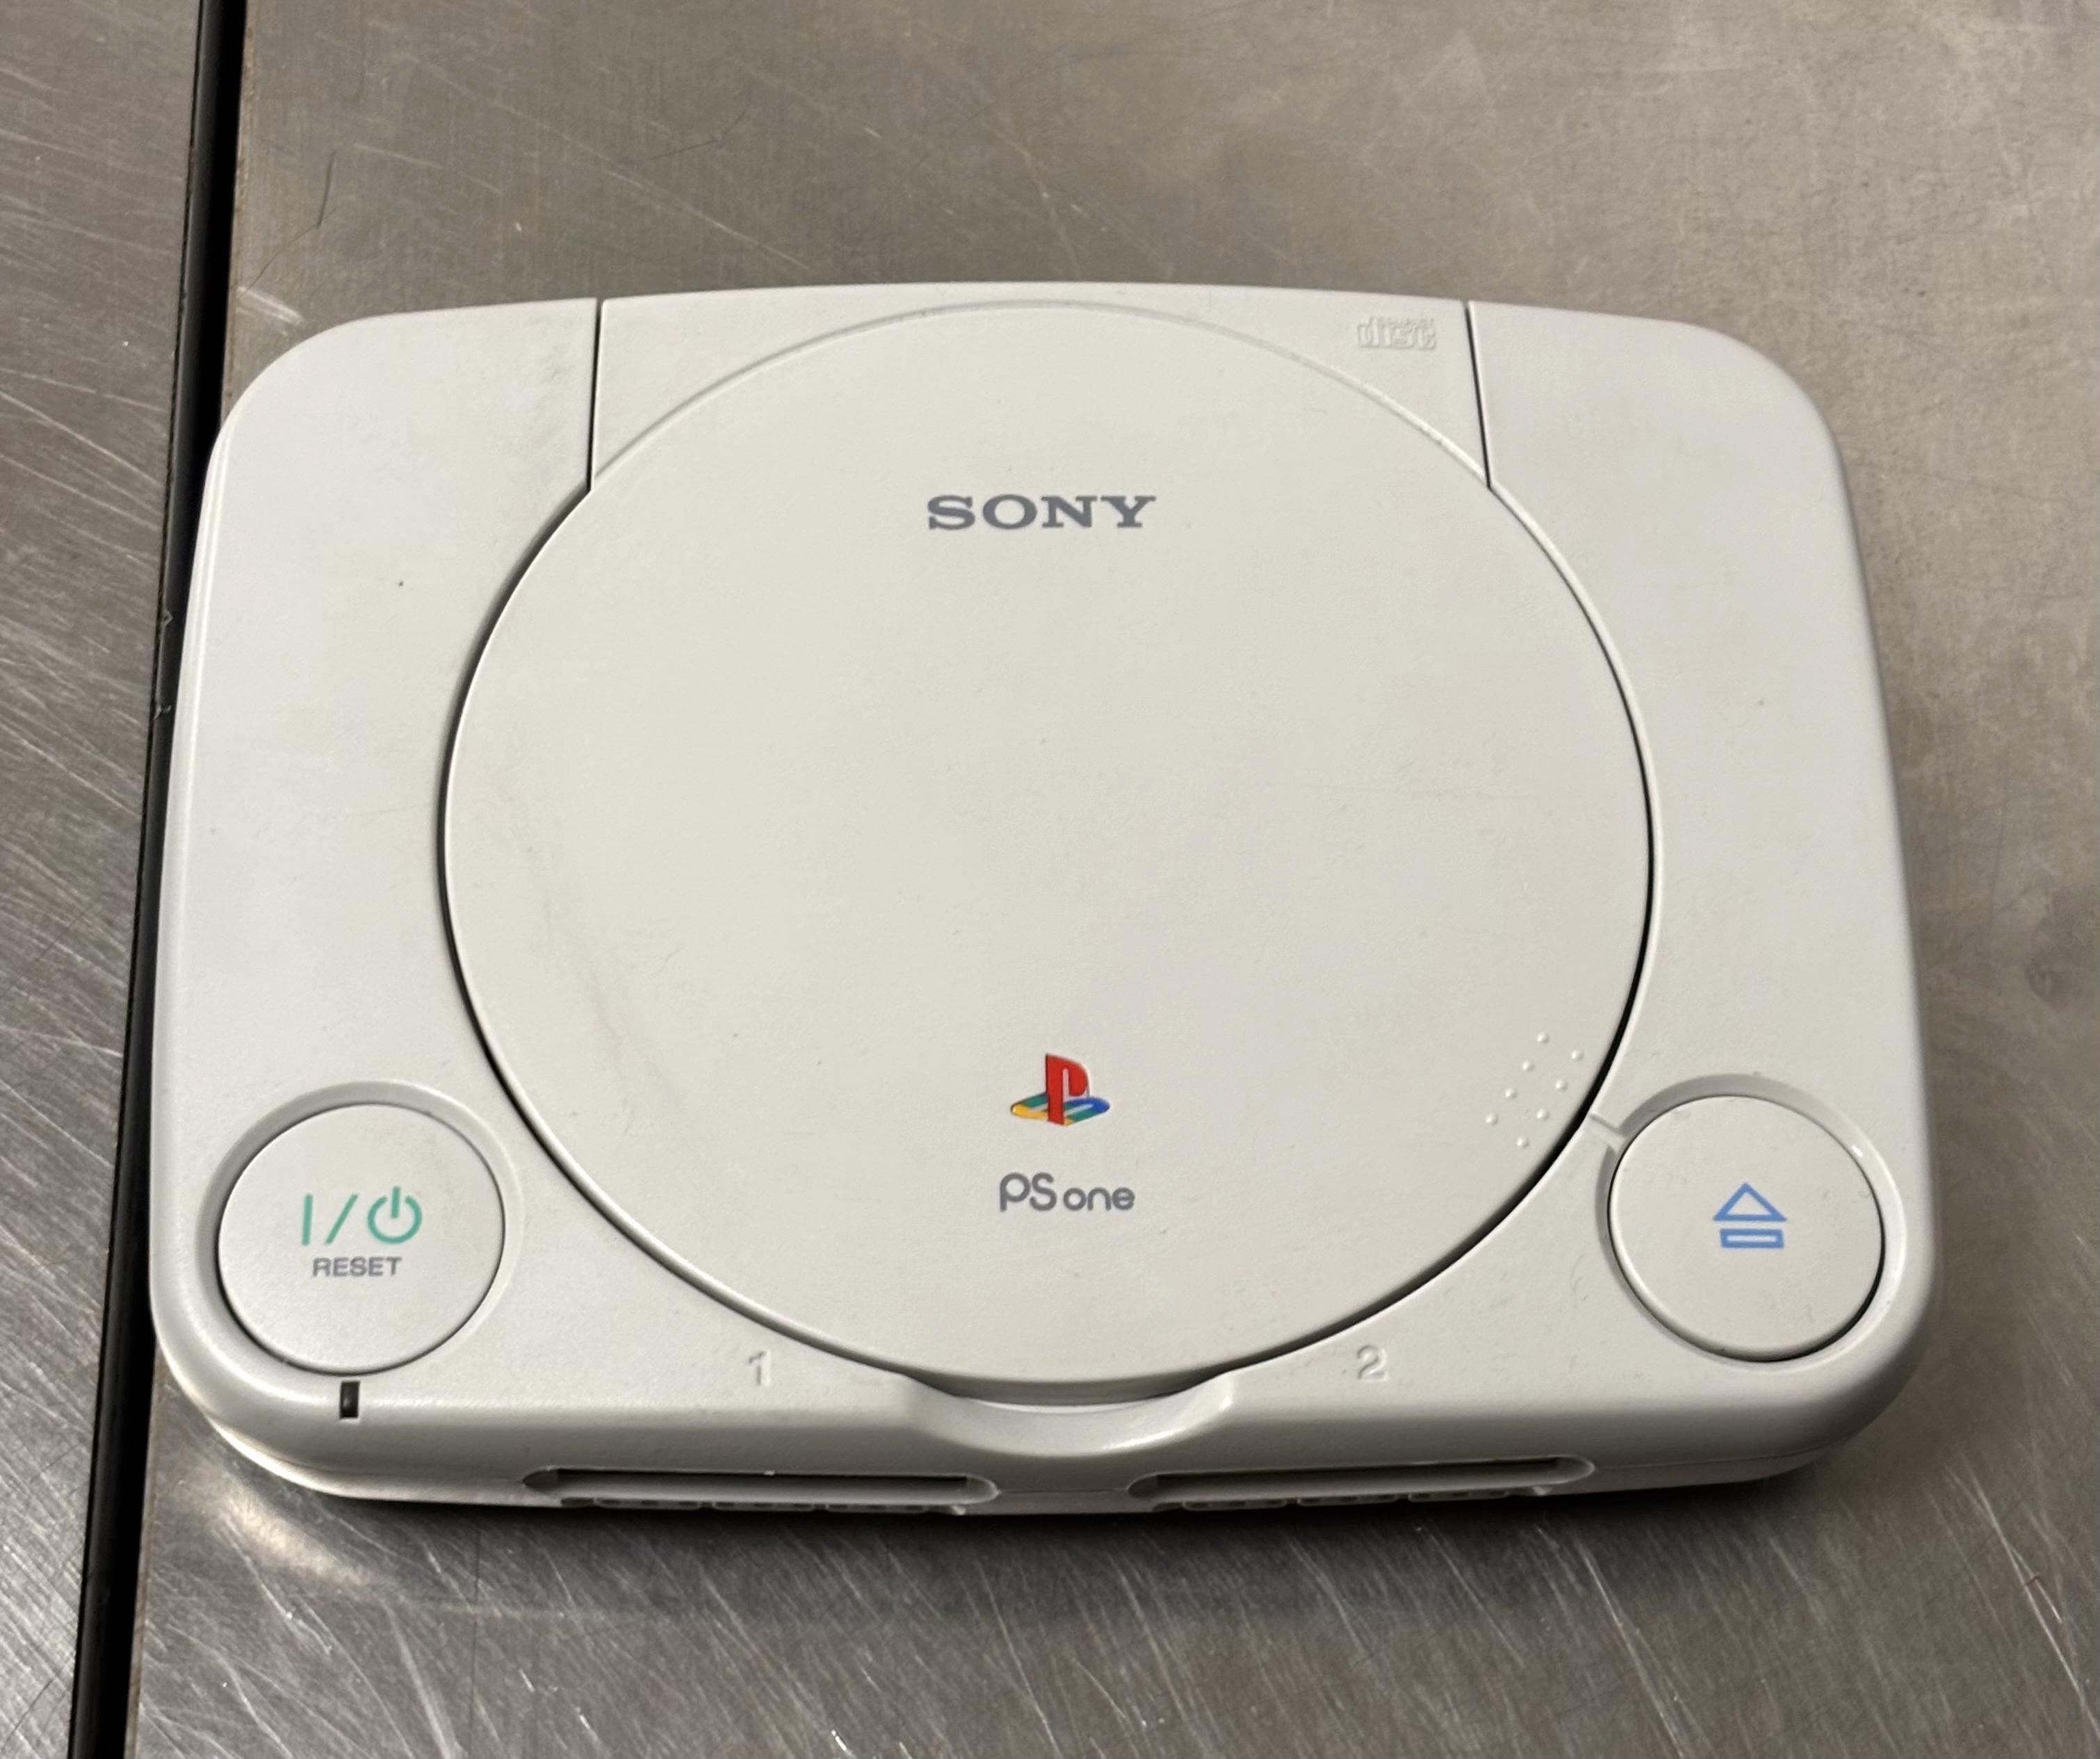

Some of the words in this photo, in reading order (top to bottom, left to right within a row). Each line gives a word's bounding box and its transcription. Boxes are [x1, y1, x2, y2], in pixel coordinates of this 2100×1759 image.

[927, 494, 1156, 530] SONY
[1063, 1187, 1135, 1211] one
[312, 1256, 402, 1277] RESET
[749, 1350, 771, 1386] 1
[1357, 1344, 1388, 1382] 2
